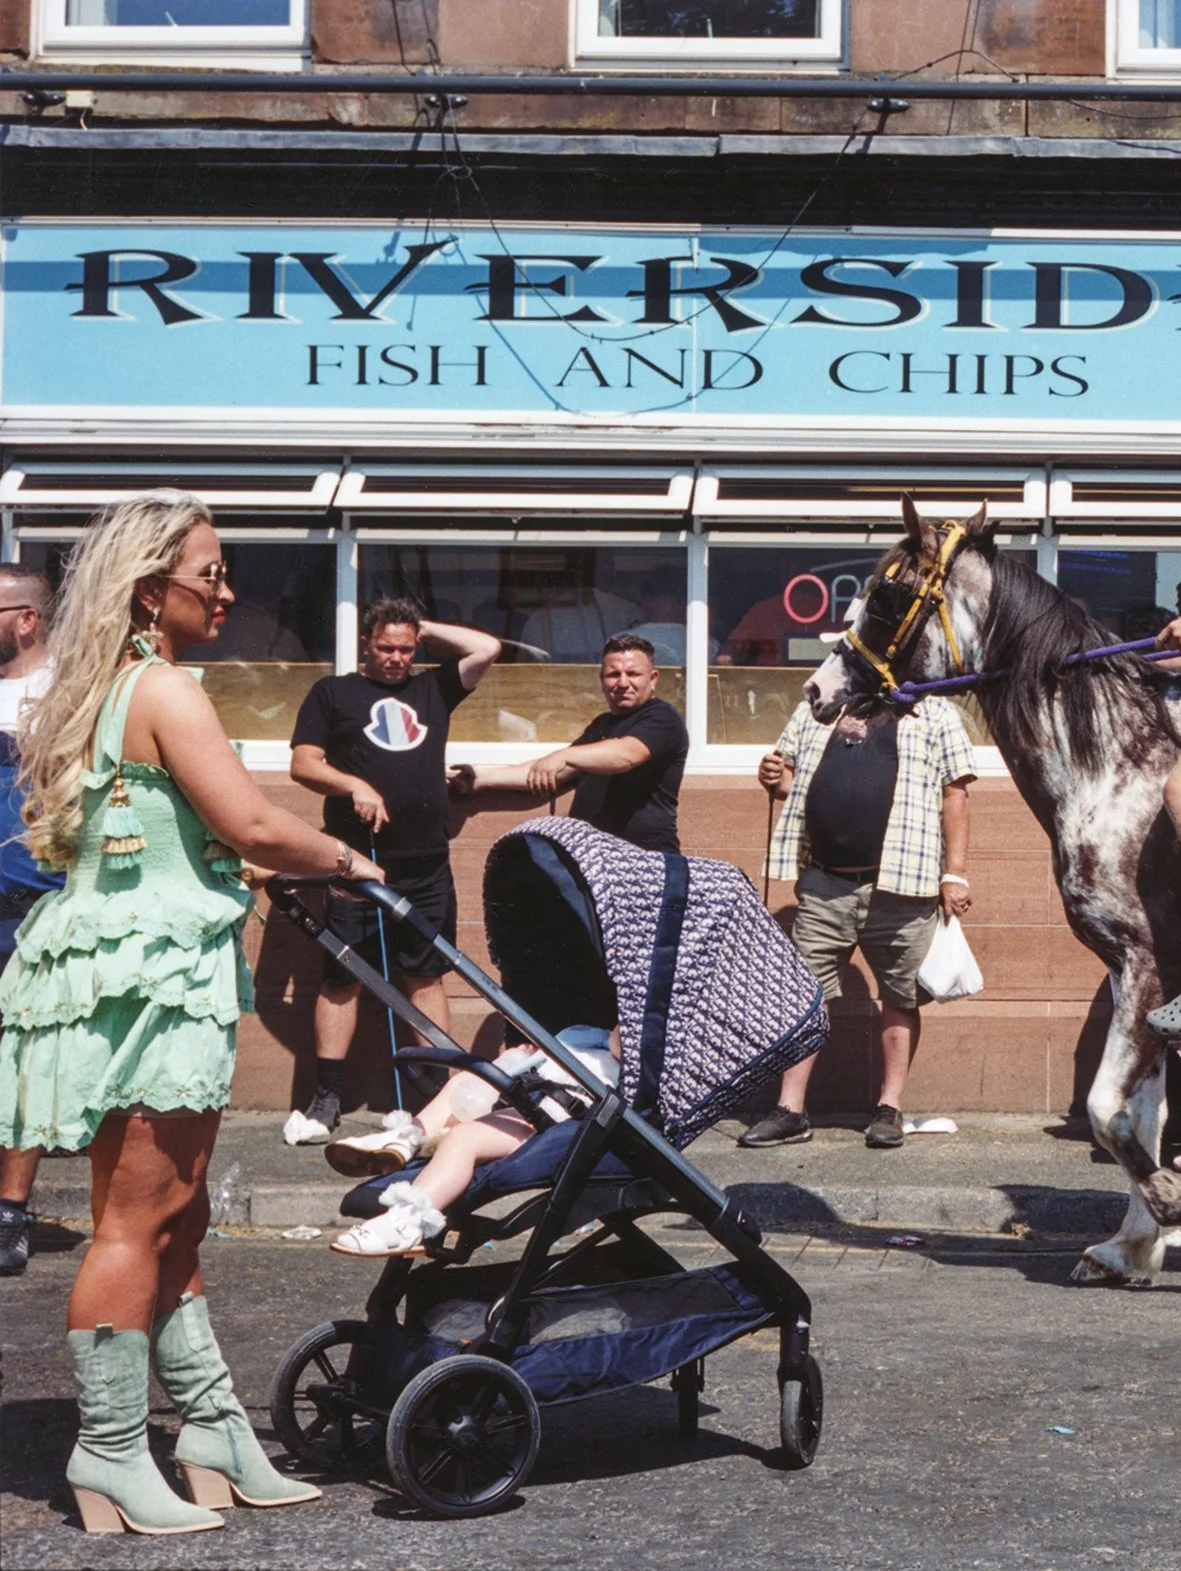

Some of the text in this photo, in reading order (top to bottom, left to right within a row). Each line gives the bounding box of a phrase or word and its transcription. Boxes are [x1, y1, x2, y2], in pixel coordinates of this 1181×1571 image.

[306, 344, 1089, 397] FISH AND CHIPS
